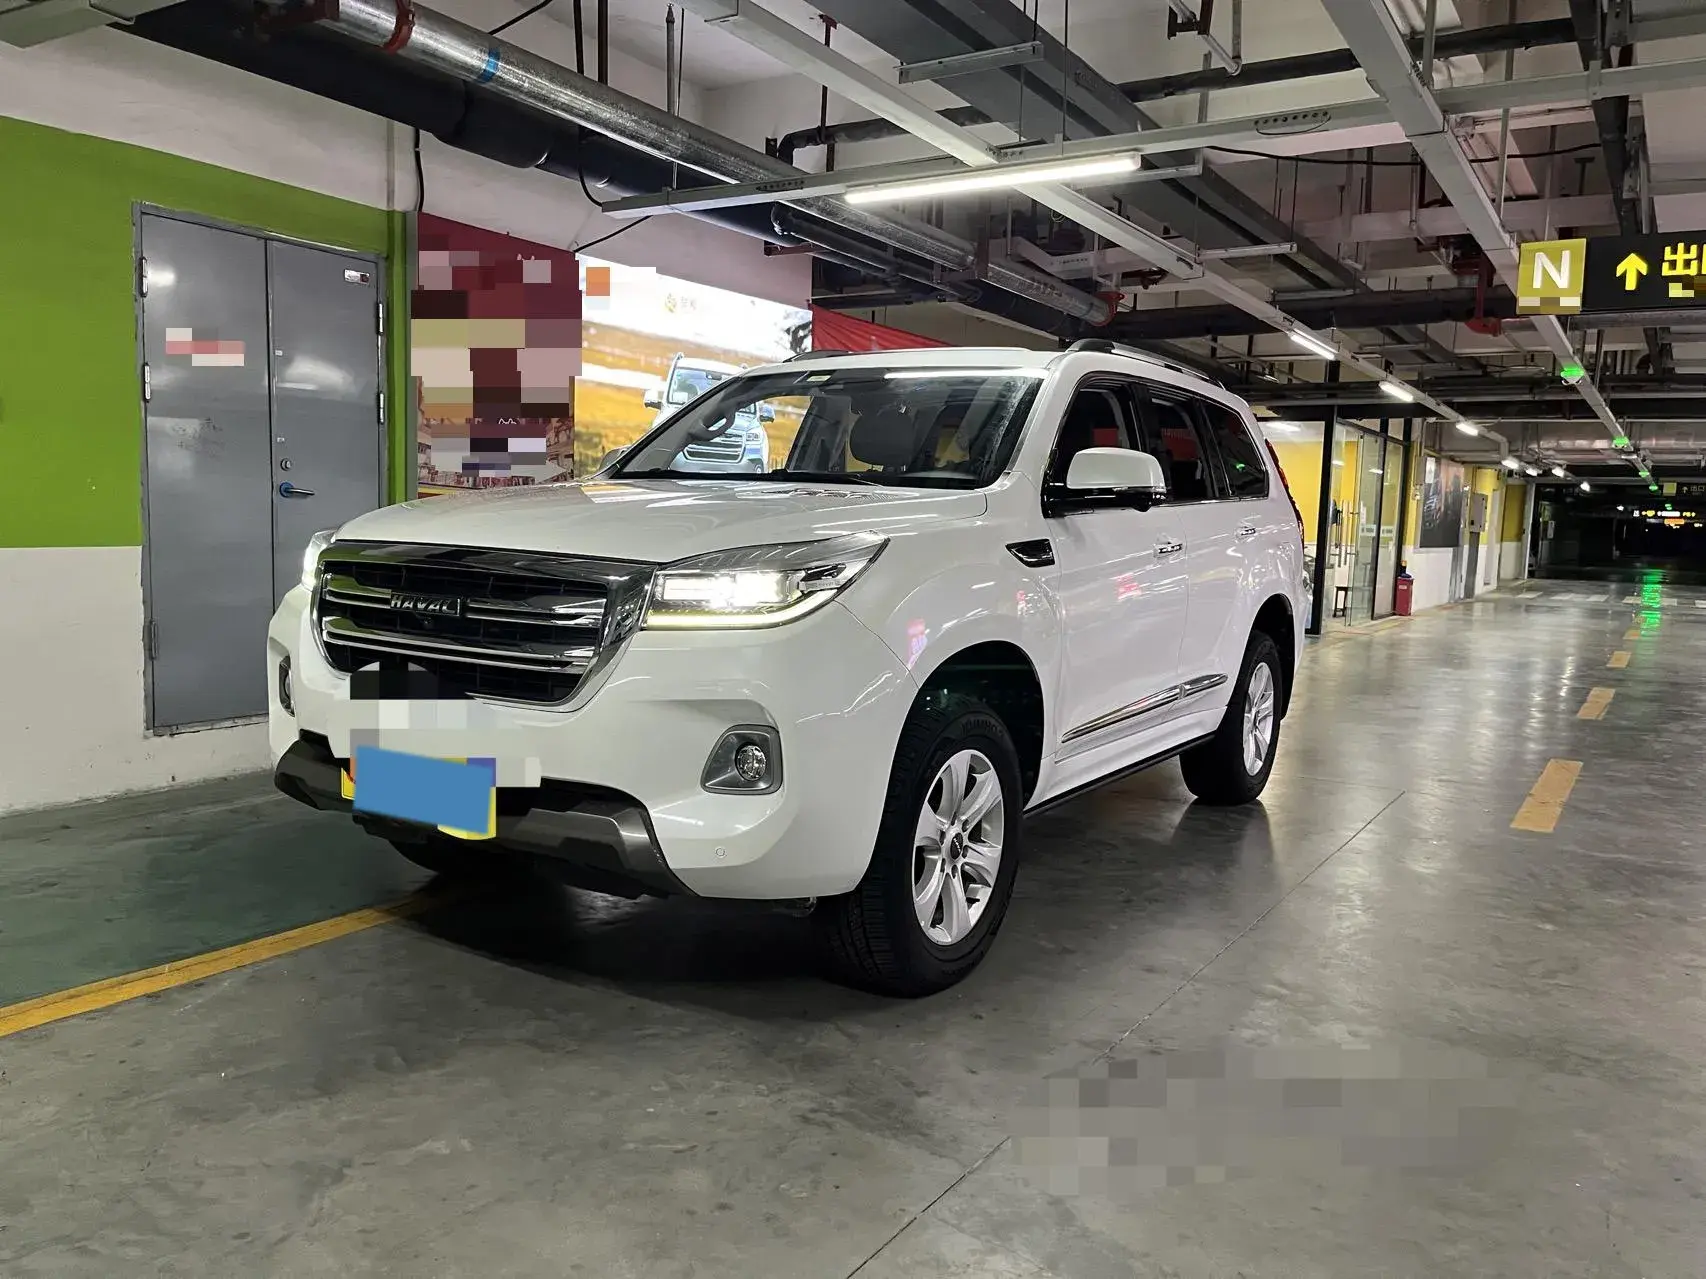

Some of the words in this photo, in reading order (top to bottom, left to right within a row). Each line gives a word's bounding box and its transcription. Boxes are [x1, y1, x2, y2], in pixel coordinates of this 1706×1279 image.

[1532, 250, 1571, 289] N
[1661, 242, 1706, 277] 出
[390, 594, 456, 614] HAVAL
